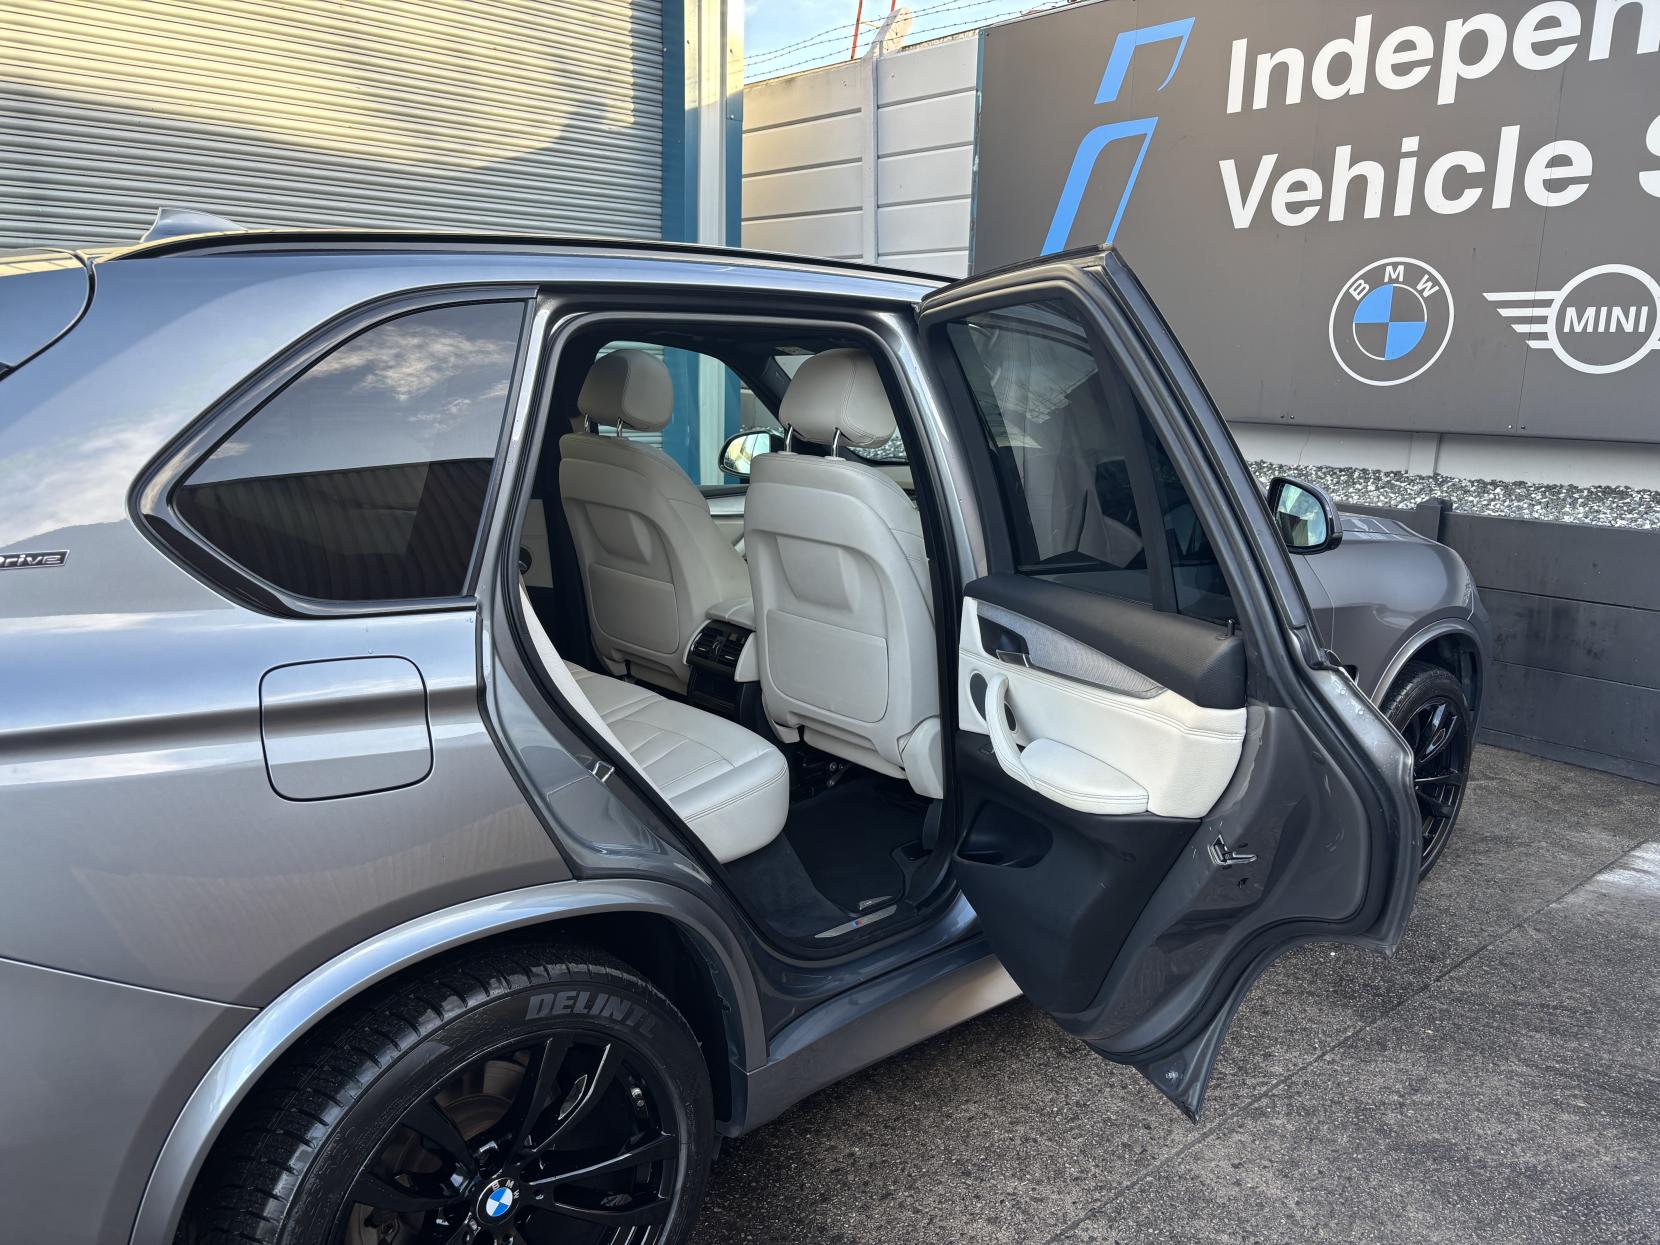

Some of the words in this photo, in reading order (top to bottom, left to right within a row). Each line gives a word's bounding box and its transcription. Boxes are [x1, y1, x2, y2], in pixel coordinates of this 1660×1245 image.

[1226, 0, 1660, 114] Indepen
[1218, 124, 1594, 229] Vehicle
[1348, 264, 1440, 301] BMW
[1562, 305, 1649, 334] MINI
[491, 1179, 520, 1199] BMW
